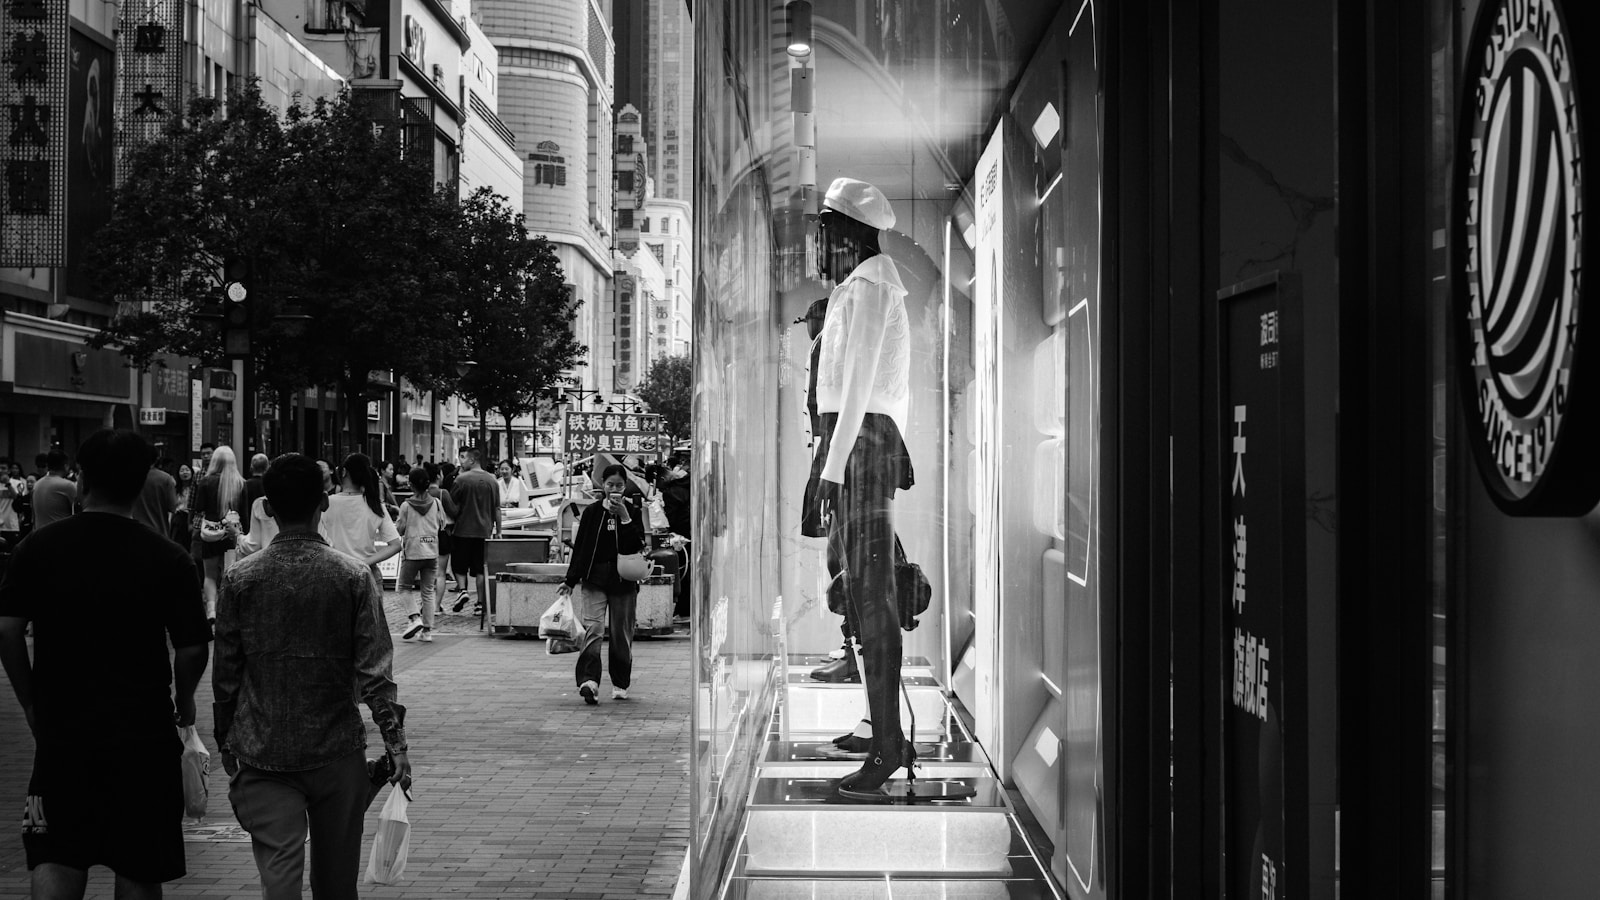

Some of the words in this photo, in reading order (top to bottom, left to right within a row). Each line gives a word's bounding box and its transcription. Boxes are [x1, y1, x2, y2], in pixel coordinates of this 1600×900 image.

[1474, 0, 1565, 121] BOSIDENG
[567, 434, 639, 452] 长沙臭豆腐
[568, 414, 640, 432] 铁板鱿鱼
[1478, 378, 1525, 482] SINCE
[1531, 368, 1566, 476] 1976
[1232, 405, 1247, 615] 天津
[1232, 626, 1271, 723] 旗舰店
